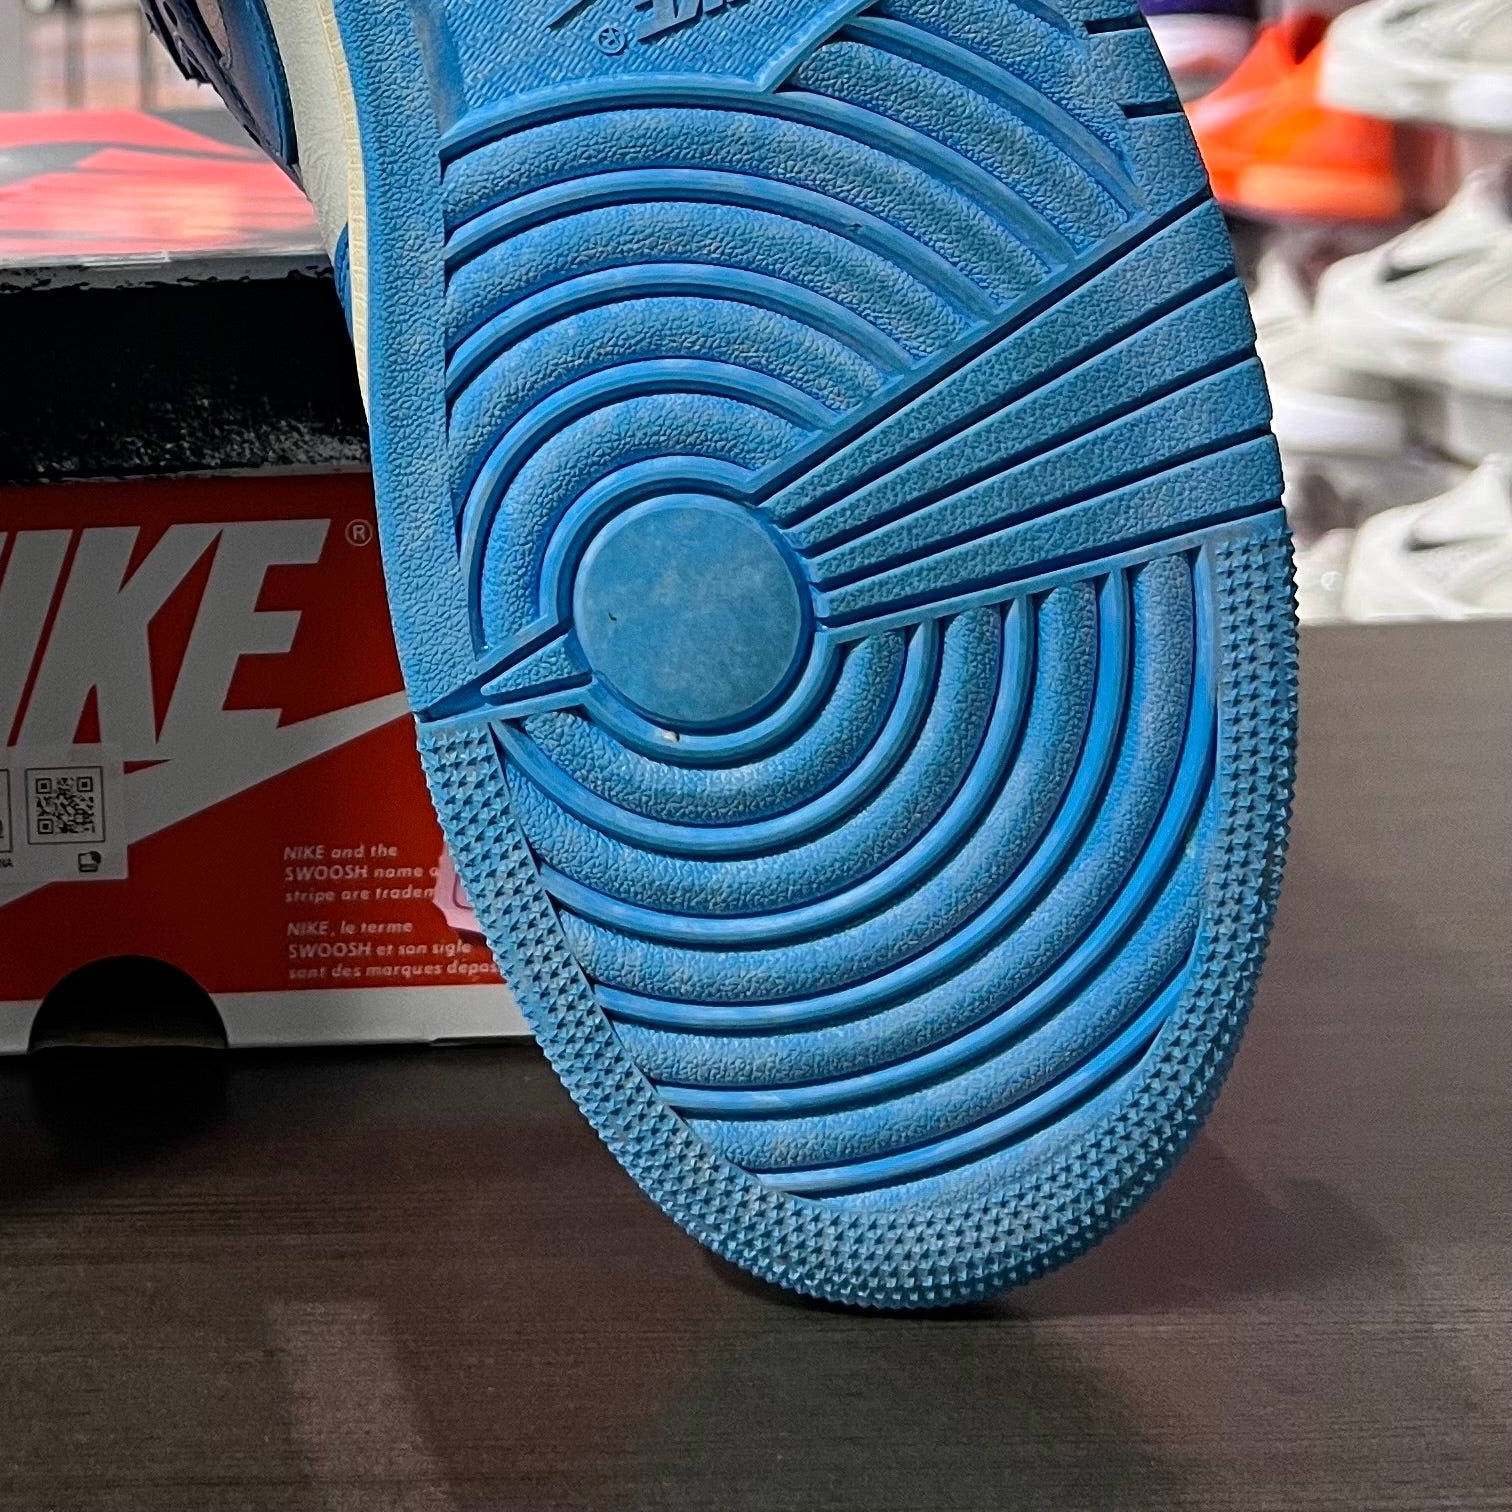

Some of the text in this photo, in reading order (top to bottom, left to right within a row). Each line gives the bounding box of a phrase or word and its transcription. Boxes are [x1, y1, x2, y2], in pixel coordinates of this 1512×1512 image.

[284, 843, 398, 860] NIKE and the
[285, 865, 368, 881] SWOOSH
[374, 867, 424, 878] name
[285, 885, 435, 904] stripe are tradem
[340, 921, 356, 934] le
[361, 921, 413, 933] terme
[288, 943, 371, 958] SWOOSH
[376, 944, 393, 956] et
[432, 939, 473, 957] sigle
[332, 964, 361, 977] des
[366, 964, 445, 979] marques
